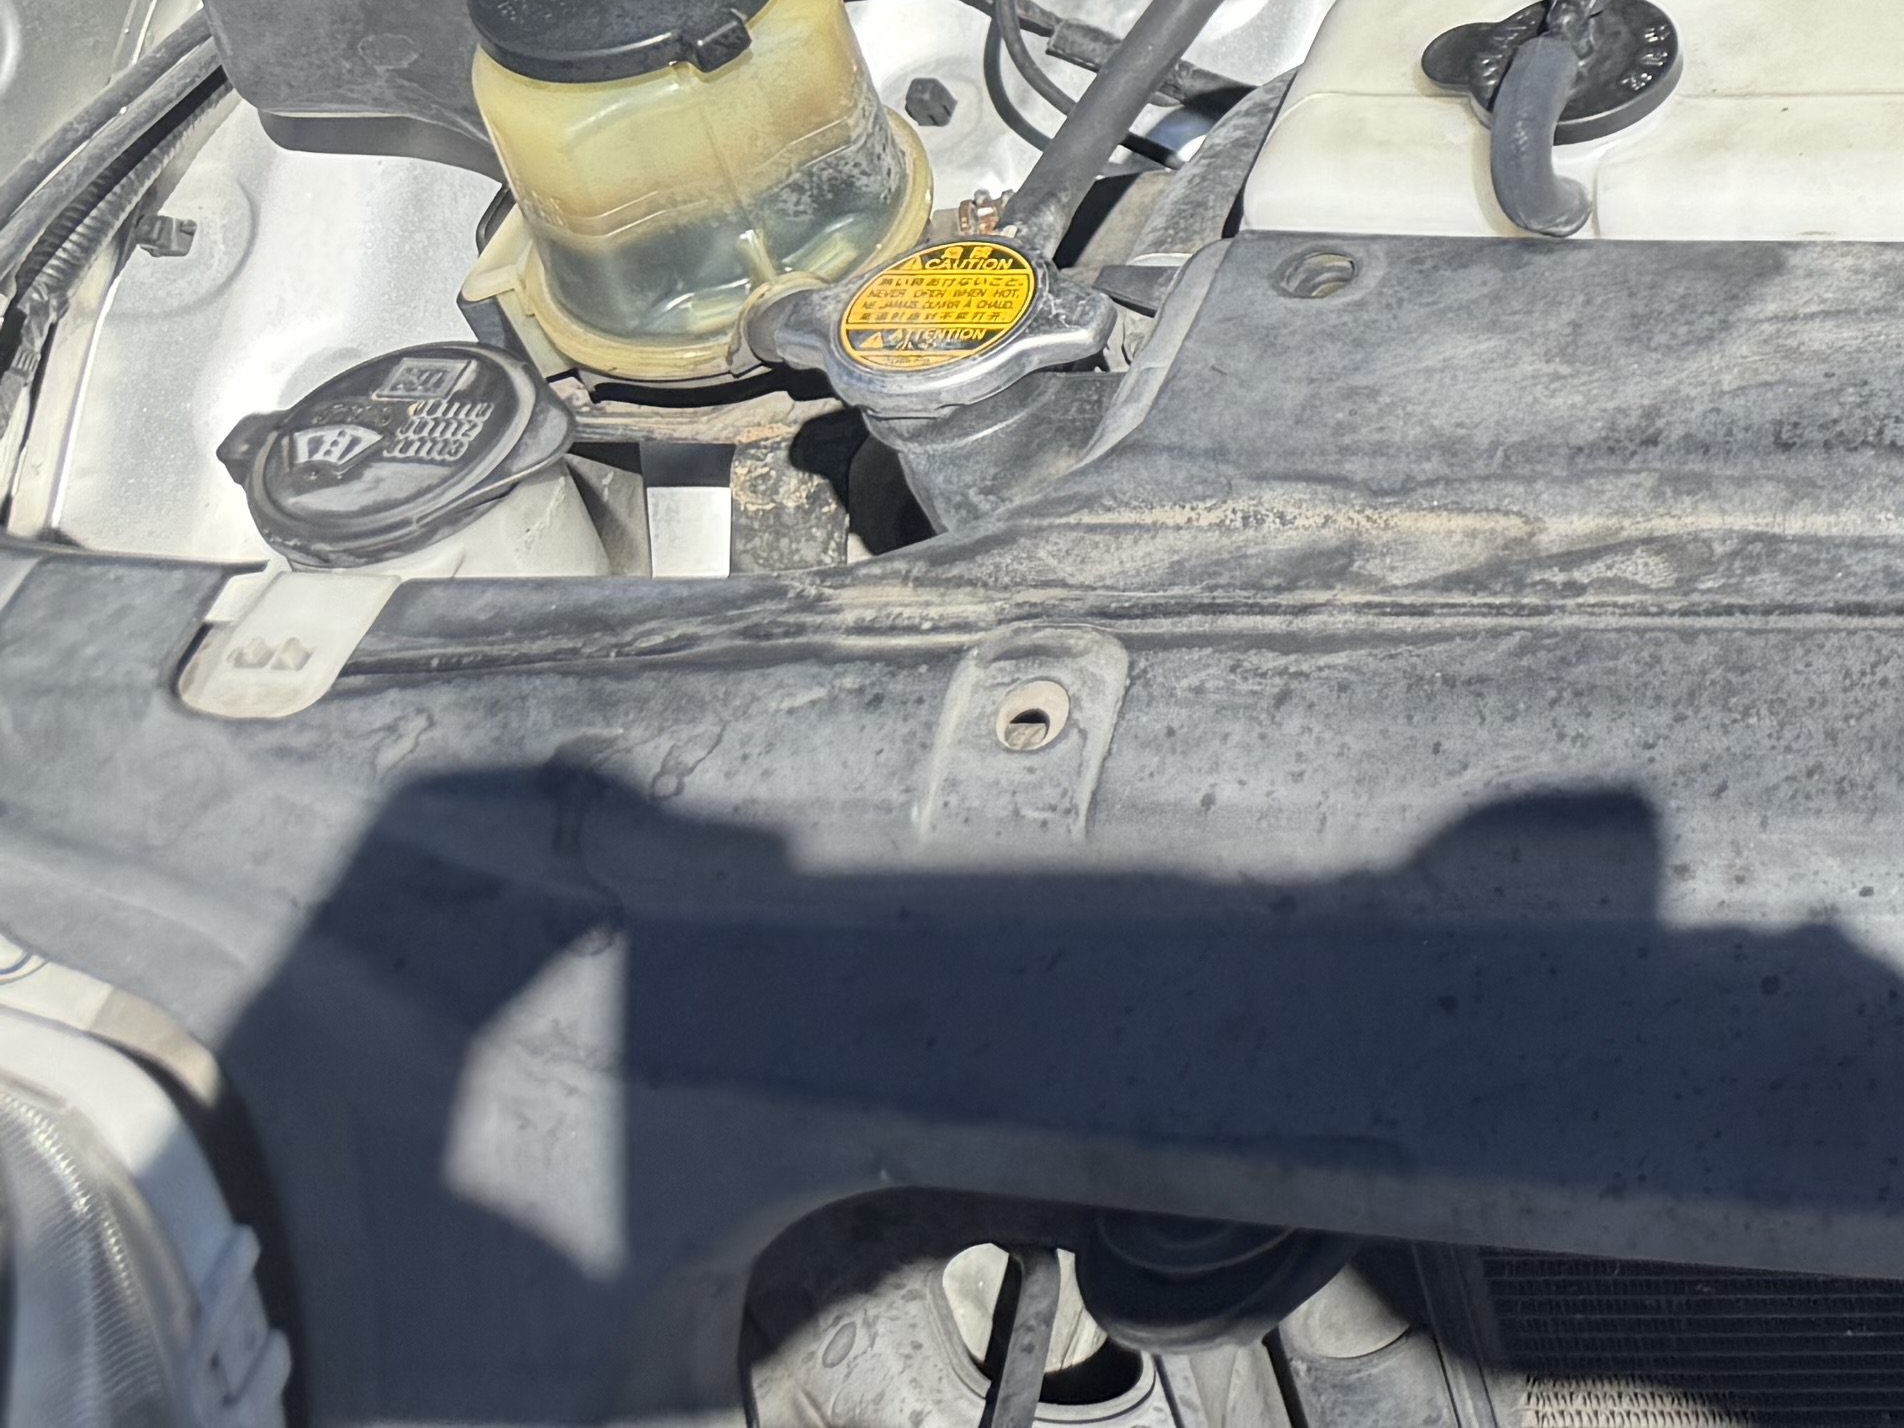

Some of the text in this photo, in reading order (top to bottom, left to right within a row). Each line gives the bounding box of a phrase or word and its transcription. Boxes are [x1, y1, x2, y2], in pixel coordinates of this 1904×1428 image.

[925, 258, 1013, 270] CAUTION
[879, 276, 1024, 287] いあけないこと。
[954, 288, 986, 298] WHEN
[888, 327, 987, 340] ATTENTION
